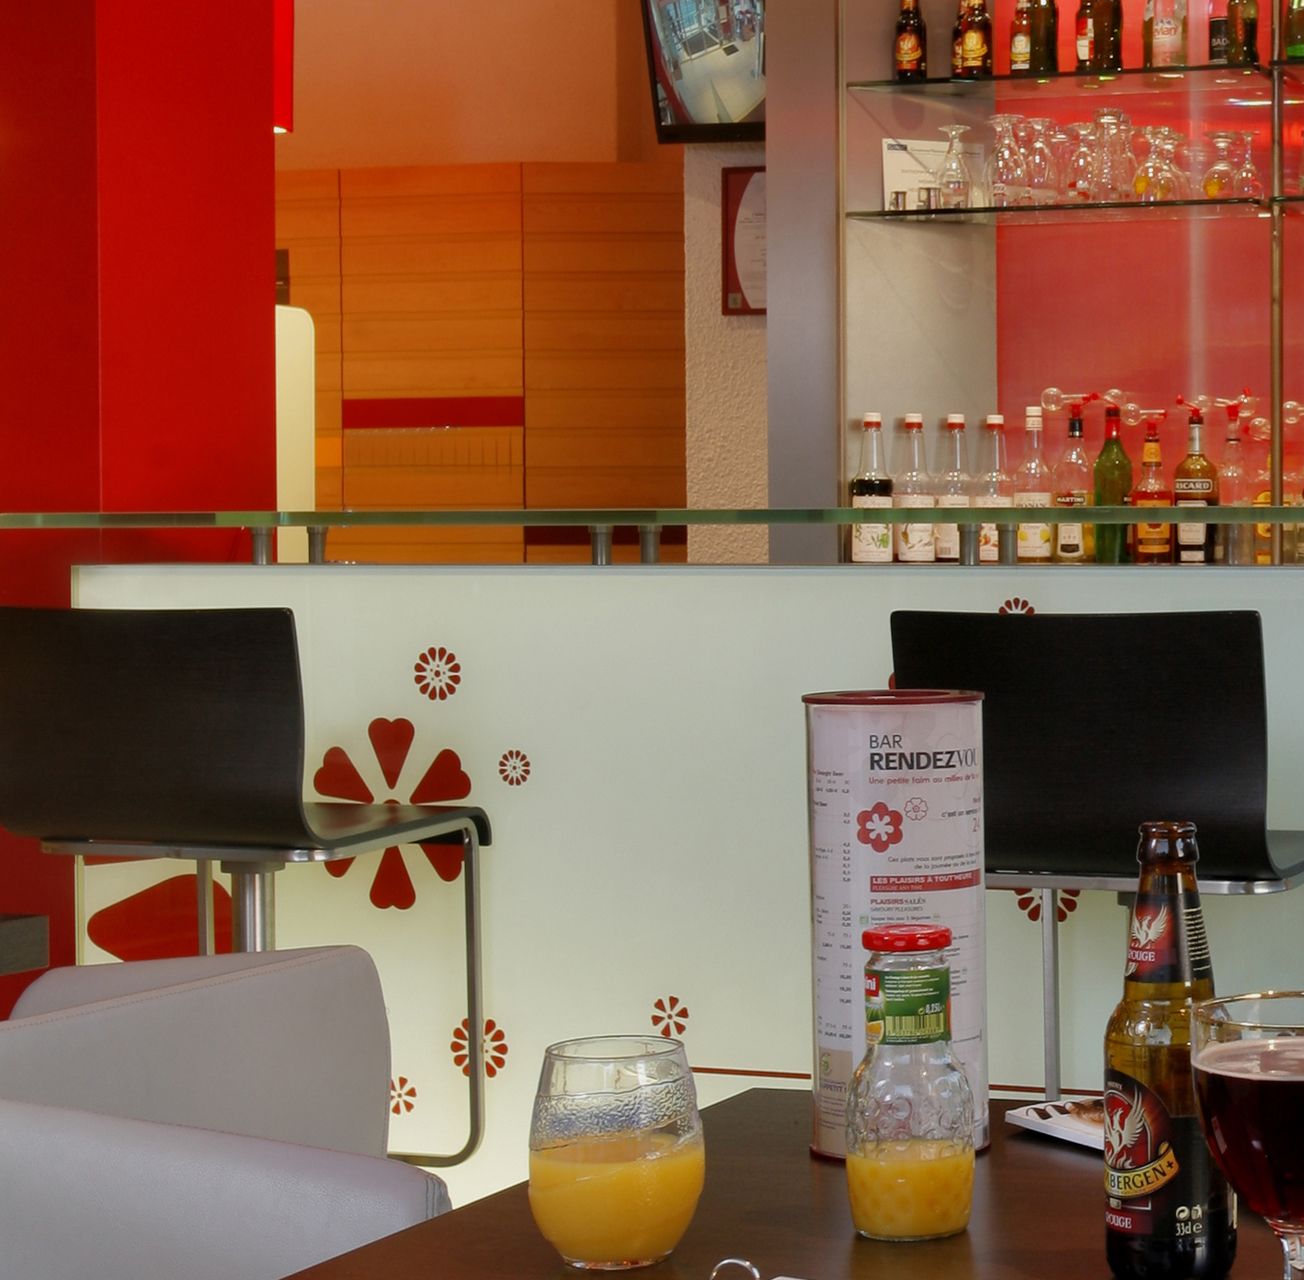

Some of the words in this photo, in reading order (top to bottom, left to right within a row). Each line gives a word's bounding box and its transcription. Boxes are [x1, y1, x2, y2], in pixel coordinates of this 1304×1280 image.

[869, 734, 902, 749] BAR
[868, 776, 884, 785] Une
[911, 775, 930, 784] faim
[889, 876, 925, 884] PLAISIRS
